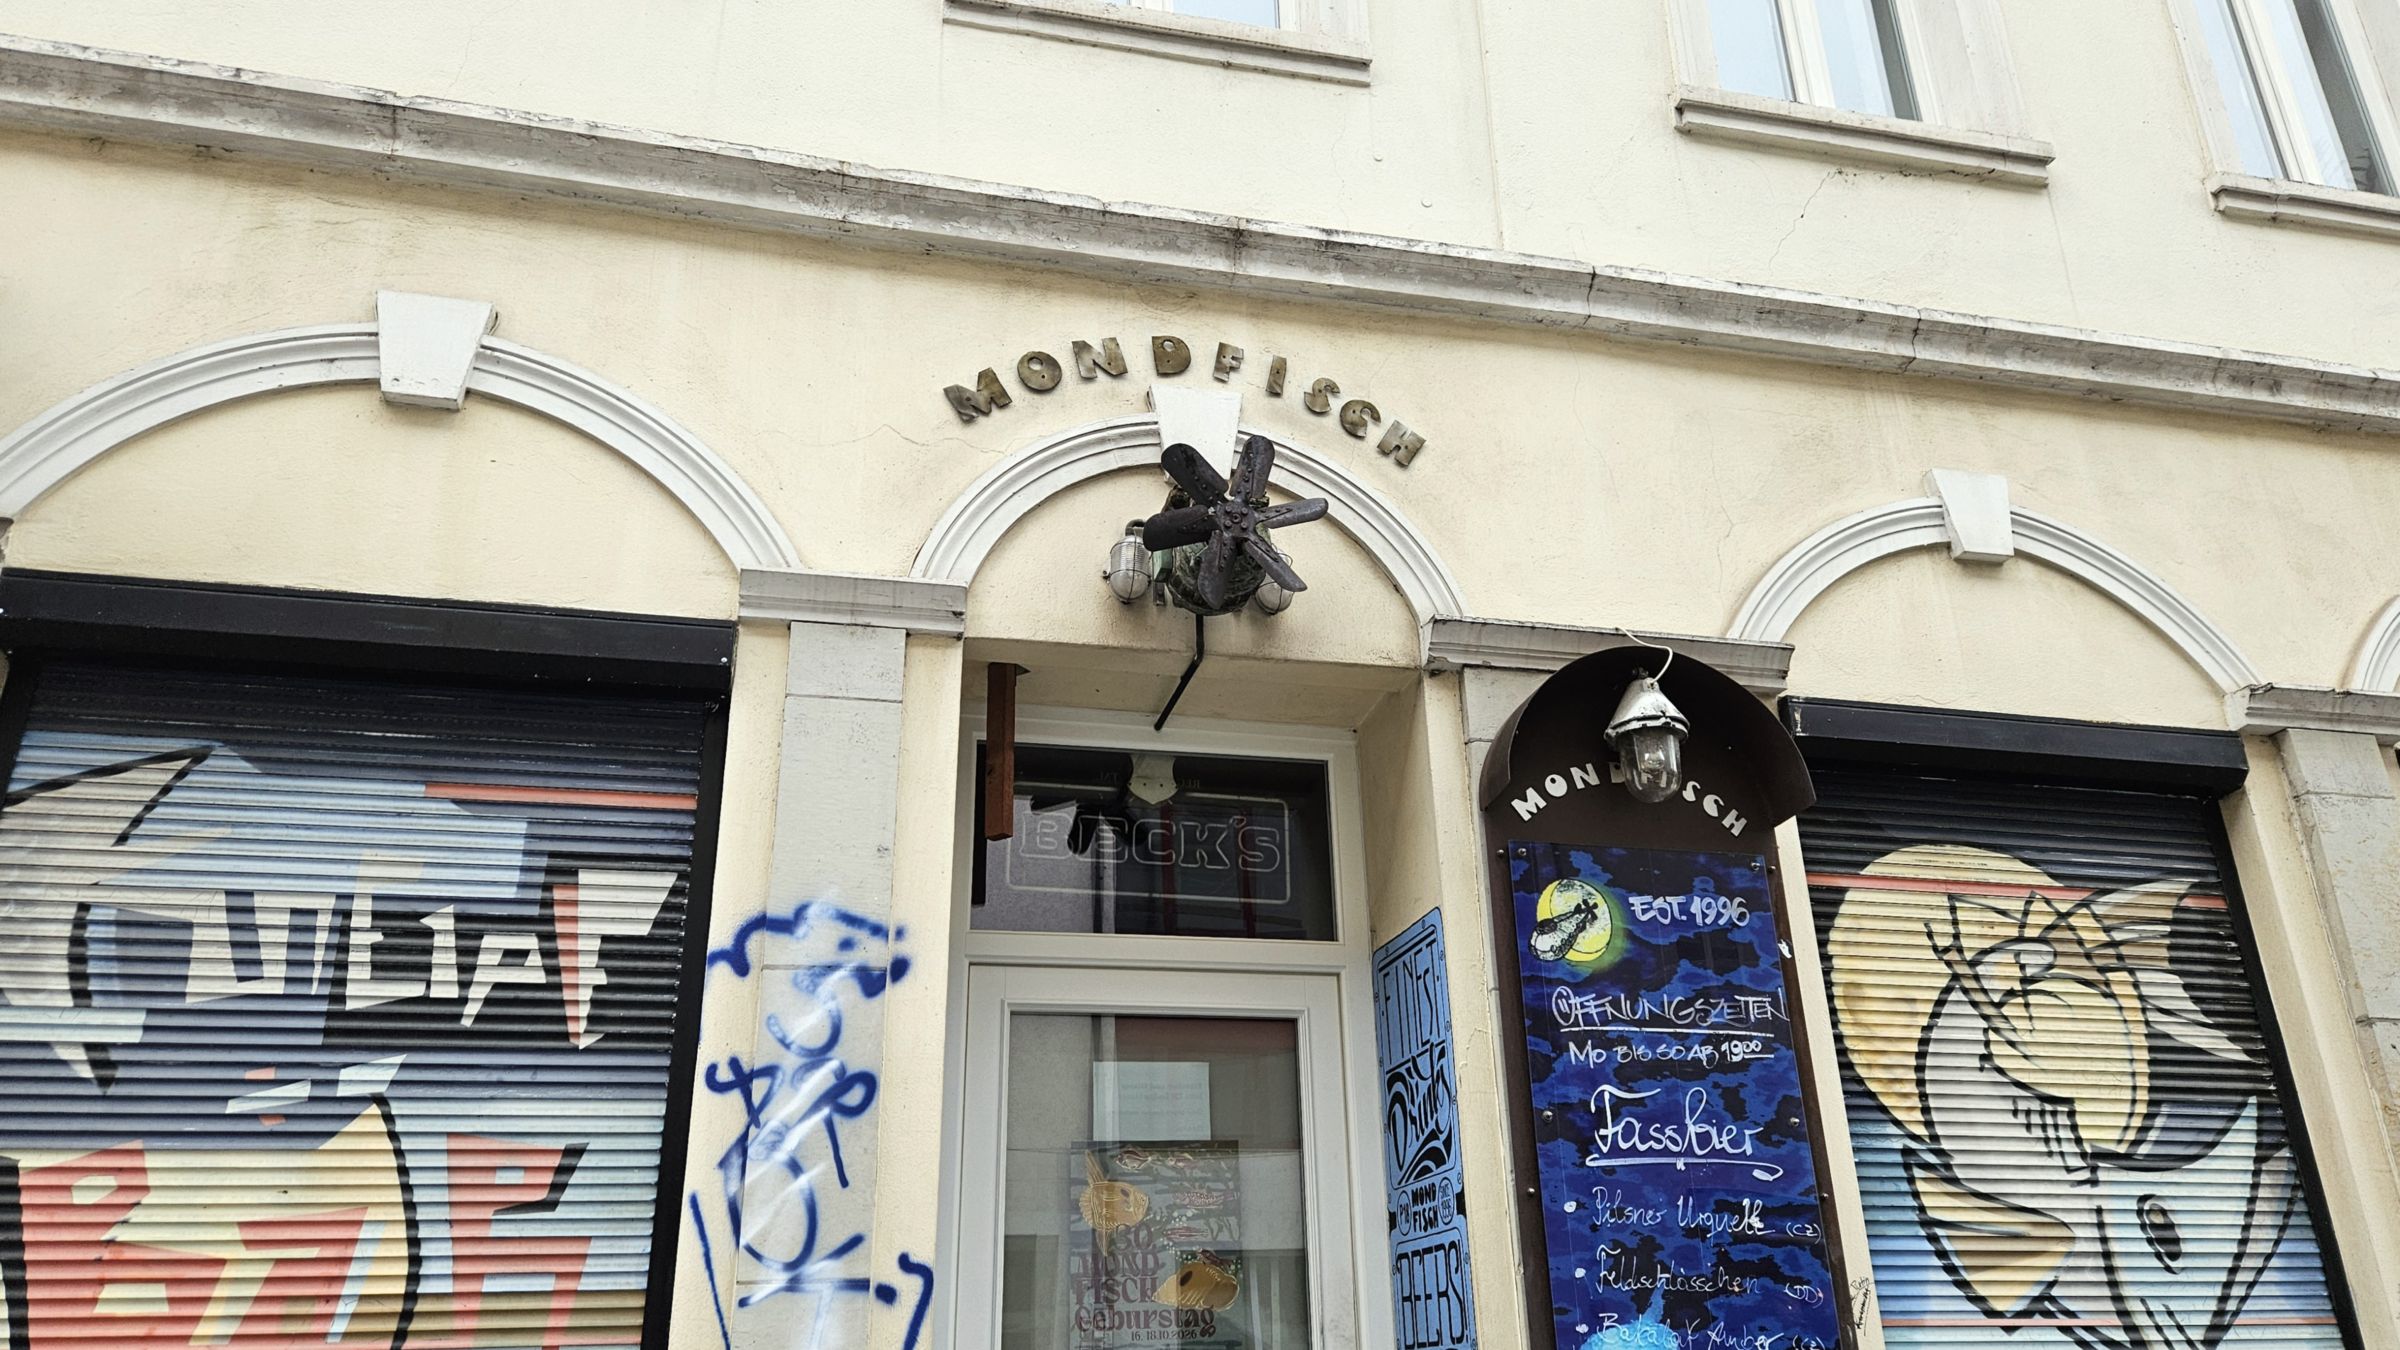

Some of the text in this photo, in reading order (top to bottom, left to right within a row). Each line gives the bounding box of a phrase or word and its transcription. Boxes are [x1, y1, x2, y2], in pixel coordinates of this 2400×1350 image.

[943, 335, 1427, 467] MONDFISCH
[1020, 811, 1281, 872] BECK'S
[1382, 938, 1440, 1065] FINEST
[1552, 986, 1790, 1027] ÖFFNUNGSZEITEN
[1687, 1043, 1719, 1069] AB
[1386, 1043, 1451, 1172] Drinks
[1590, 1084, 1764, 1157] Fassbier
[1411, 1182, 1437, 1207] MOND
[1412, 1205, 1440, 1233] FISCH
[1592, 1186, 1821, 1246] Pilsner Urquell (CZ)
